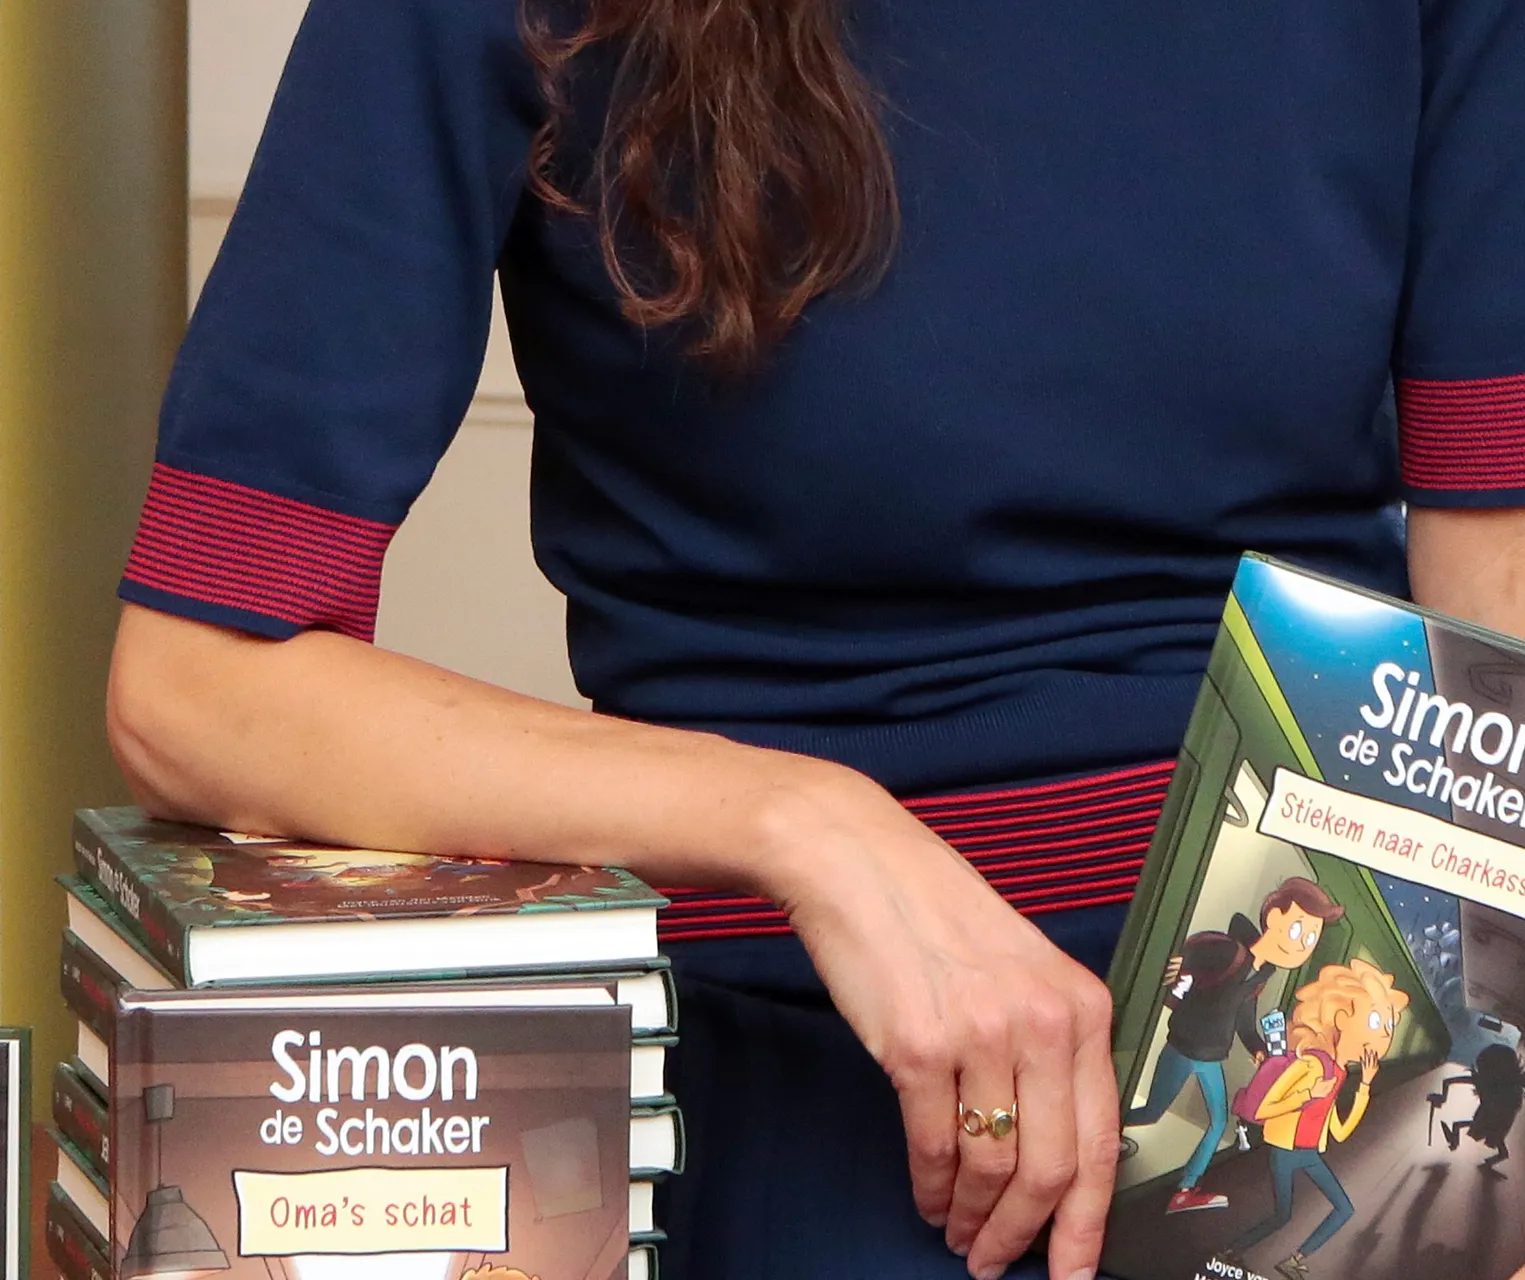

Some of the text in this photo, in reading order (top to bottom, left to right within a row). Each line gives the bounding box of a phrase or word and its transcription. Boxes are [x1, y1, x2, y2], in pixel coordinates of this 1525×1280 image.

[1339, 730, 1379, 766] de
[1281, 792, 1364, 842] Stiekem
[1373, 828, 1424, 862] naar
[269, 1029, 478, 1104] Simon
[260, 1107, 490, 1156] de Schaker
[270, 1195, 472, 1229] Oma's schat
[1206, 1256, 1243, 1280] Joyce
